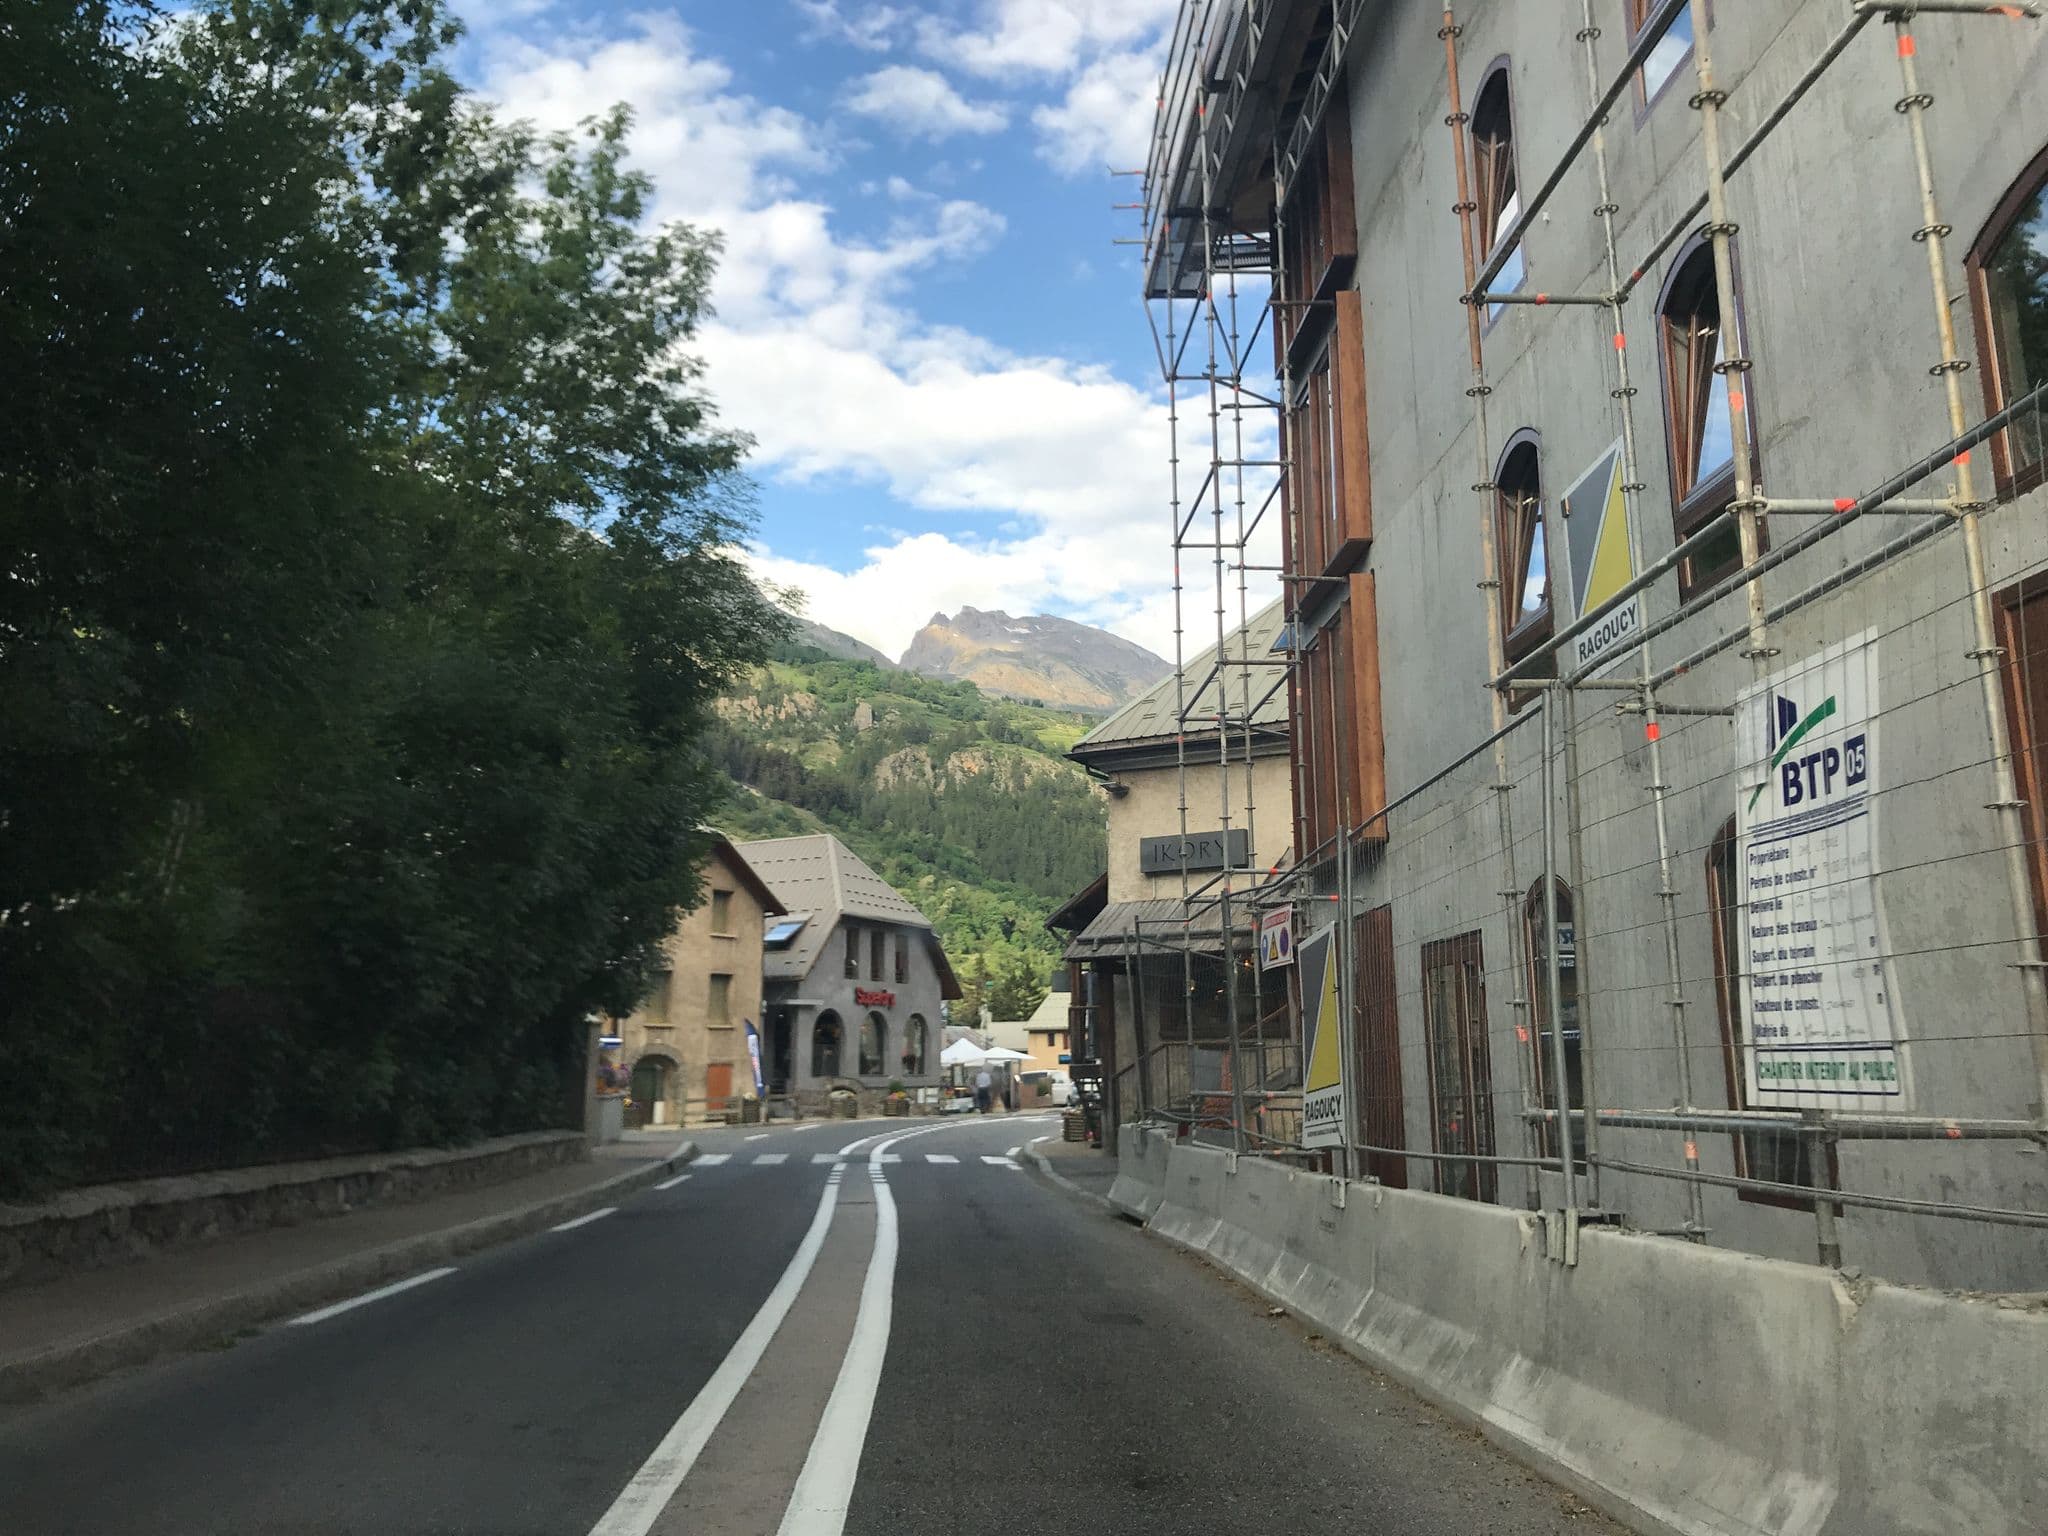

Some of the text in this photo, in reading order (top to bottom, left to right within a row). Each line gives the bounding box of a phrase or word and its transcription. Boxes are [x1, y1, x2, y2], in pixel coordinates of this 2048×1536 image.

[1579, 603, 1636, 663] RAGOUCY
[1782, 744, 1865, 807] BTP 05
[1154, 839, 1226, 863] IKORY
[1750, 875, 1773, 890] Permis
[1774, 872, 1783, 886] de
[1776, 923, 1789, 936] des
[1791, 919, 1818, 934] travaux
[1784, 997, 1793, 1011] de
[1753, 1024, 1778, 1038] Mairie
[1780, 1024, 1789, 1037] de
[1758, 1061, 1896, 1081] CHANTIER INTERDIT AU PUBLIC
[1305, 1094, 1342, 1123] RAGOUCY
